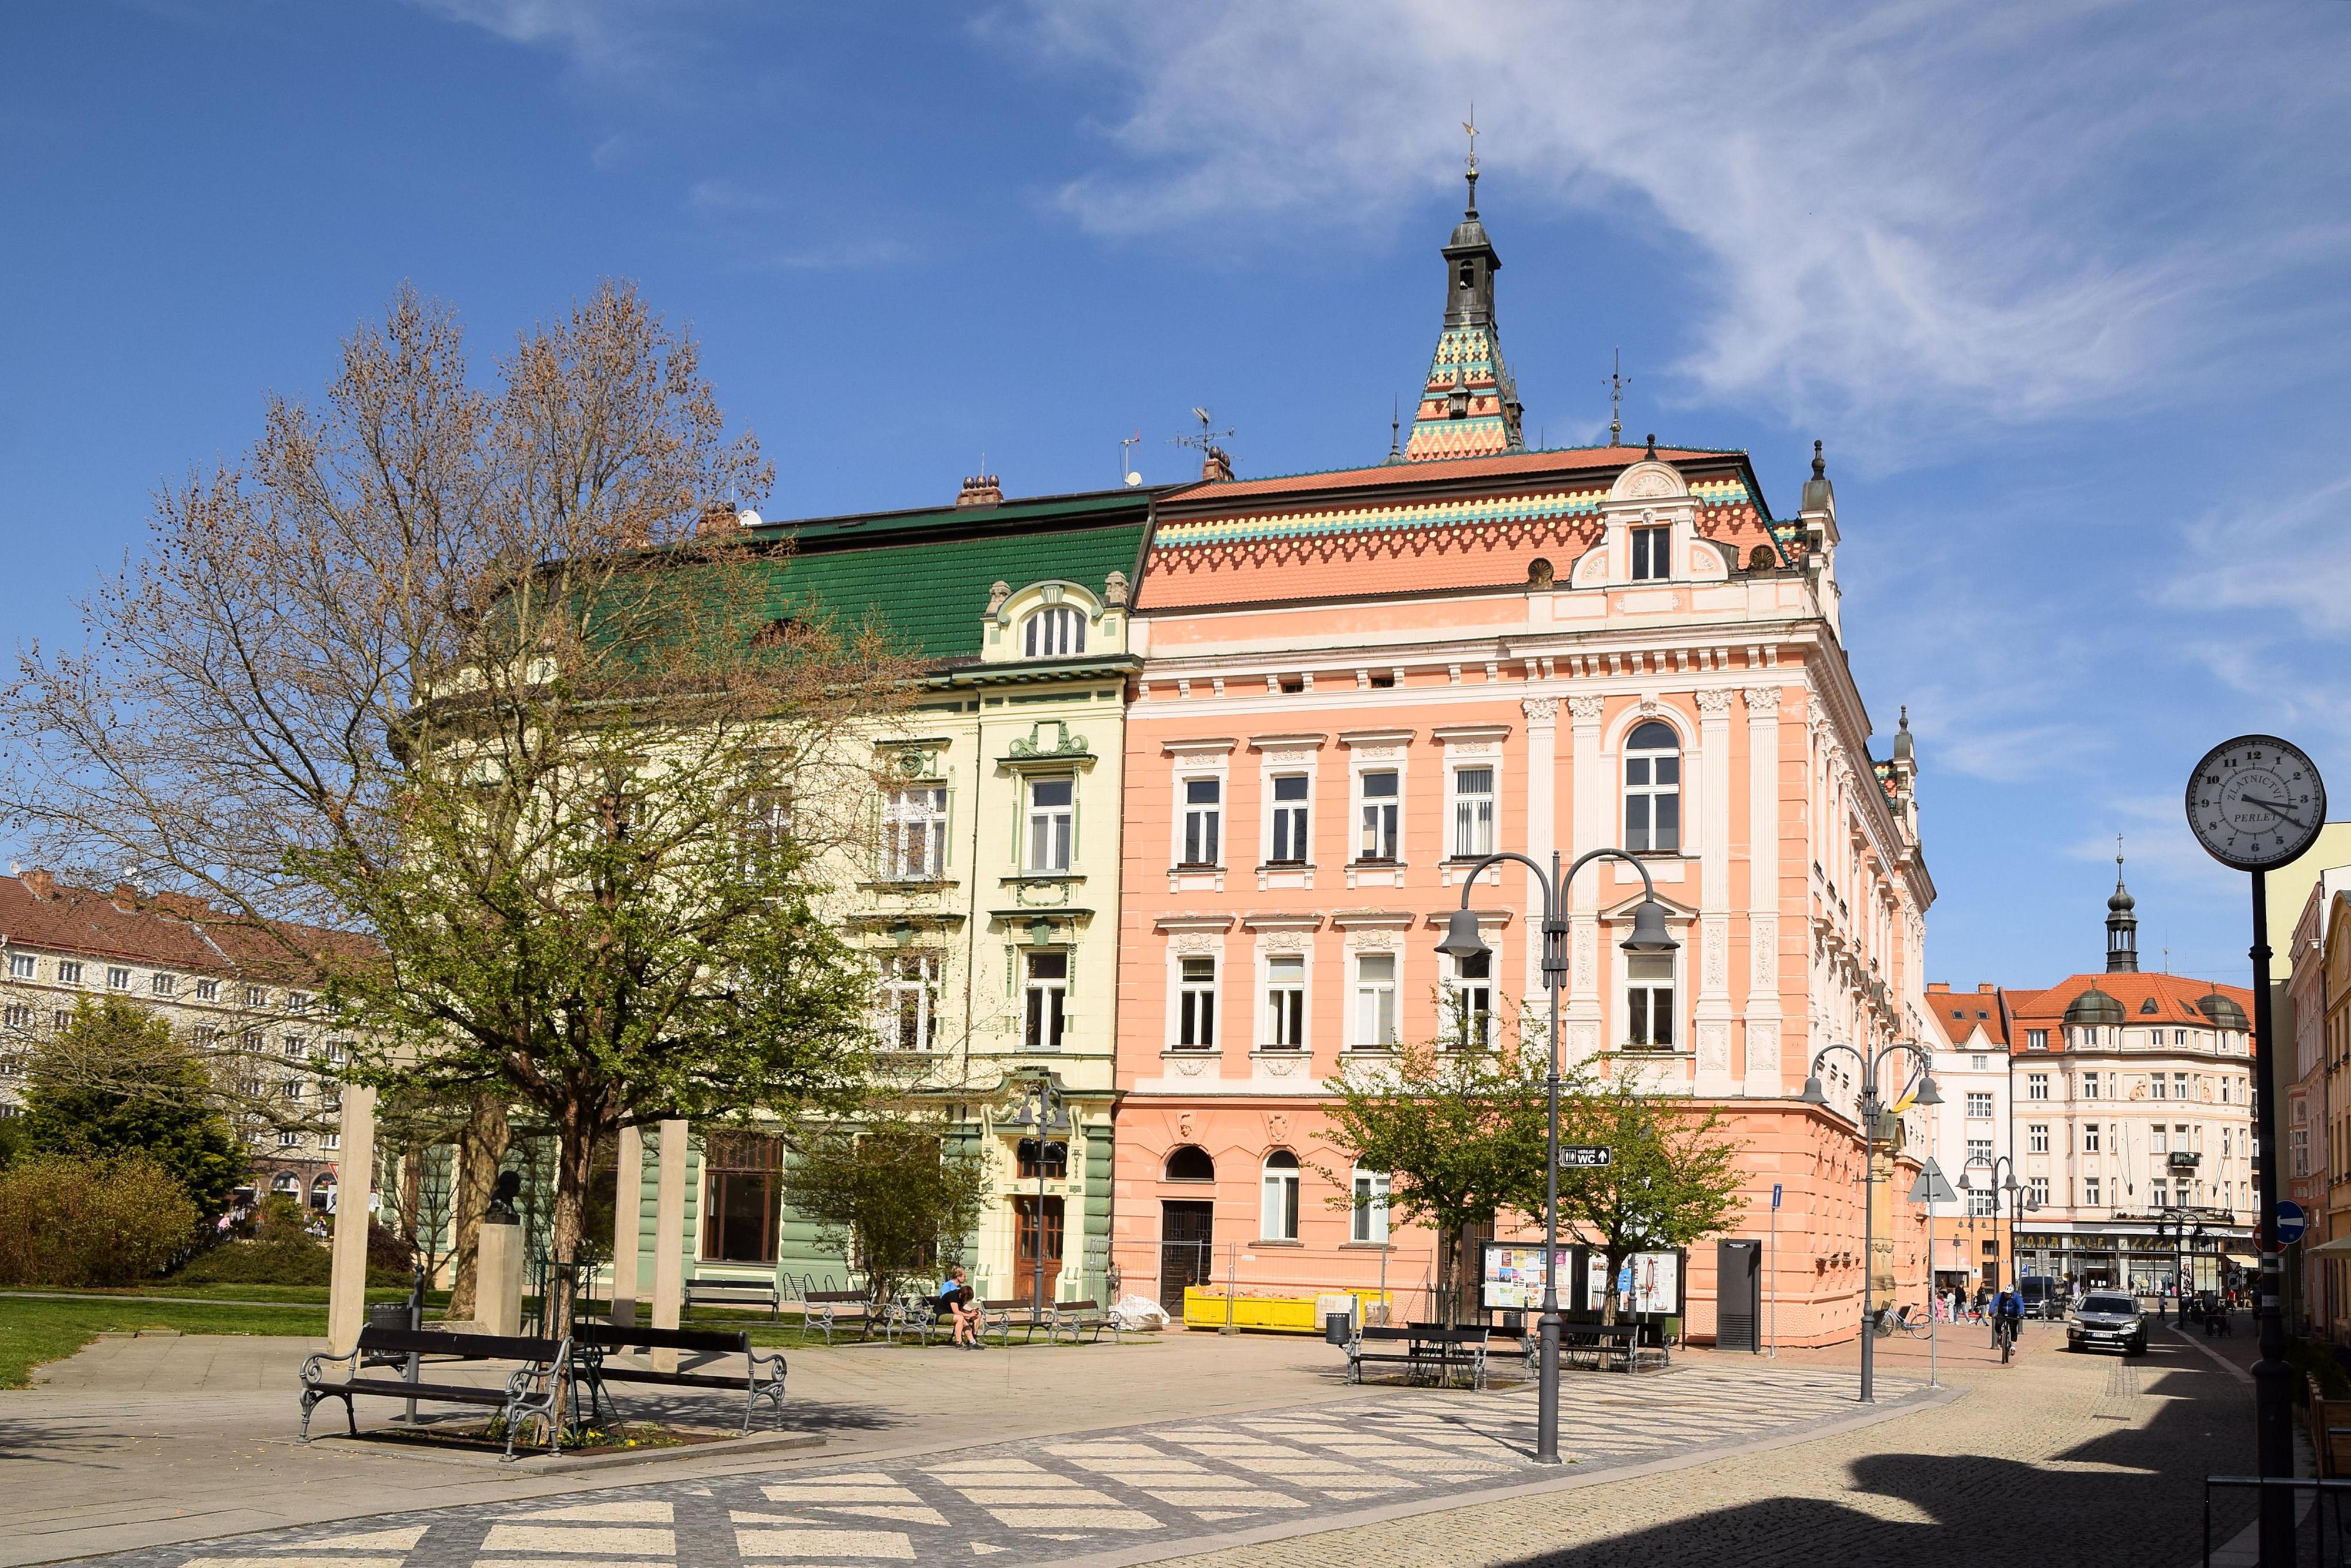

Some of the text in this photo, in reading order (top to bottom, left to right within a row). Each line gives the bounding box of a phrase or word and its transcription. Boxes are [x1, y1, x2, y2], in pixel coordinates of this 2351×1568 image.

[2246, 751, 2262, 760] 12
[2223, 758, 2238, 768] 11
[2274, 756, 2282, 765] 1
[2206, 775, 2220, 784] 10
[2293, 772, 2302, 780] 2
[2228, 775, 2285, 800] ZLATNICTVÍ
[2201, 799, 2209, 808] 9
[2300, 795, 2309, 803] 3
[2234, 813, 2278, 822] PERLET
[2209, 822, 2217, 830] 8
[2228, 837, 2235, 846] 7
[2276, 836, 2284, 845] 5
[2251, 843, 2260, 852] 6
[1578, 1154, 1596, 1164] WC
